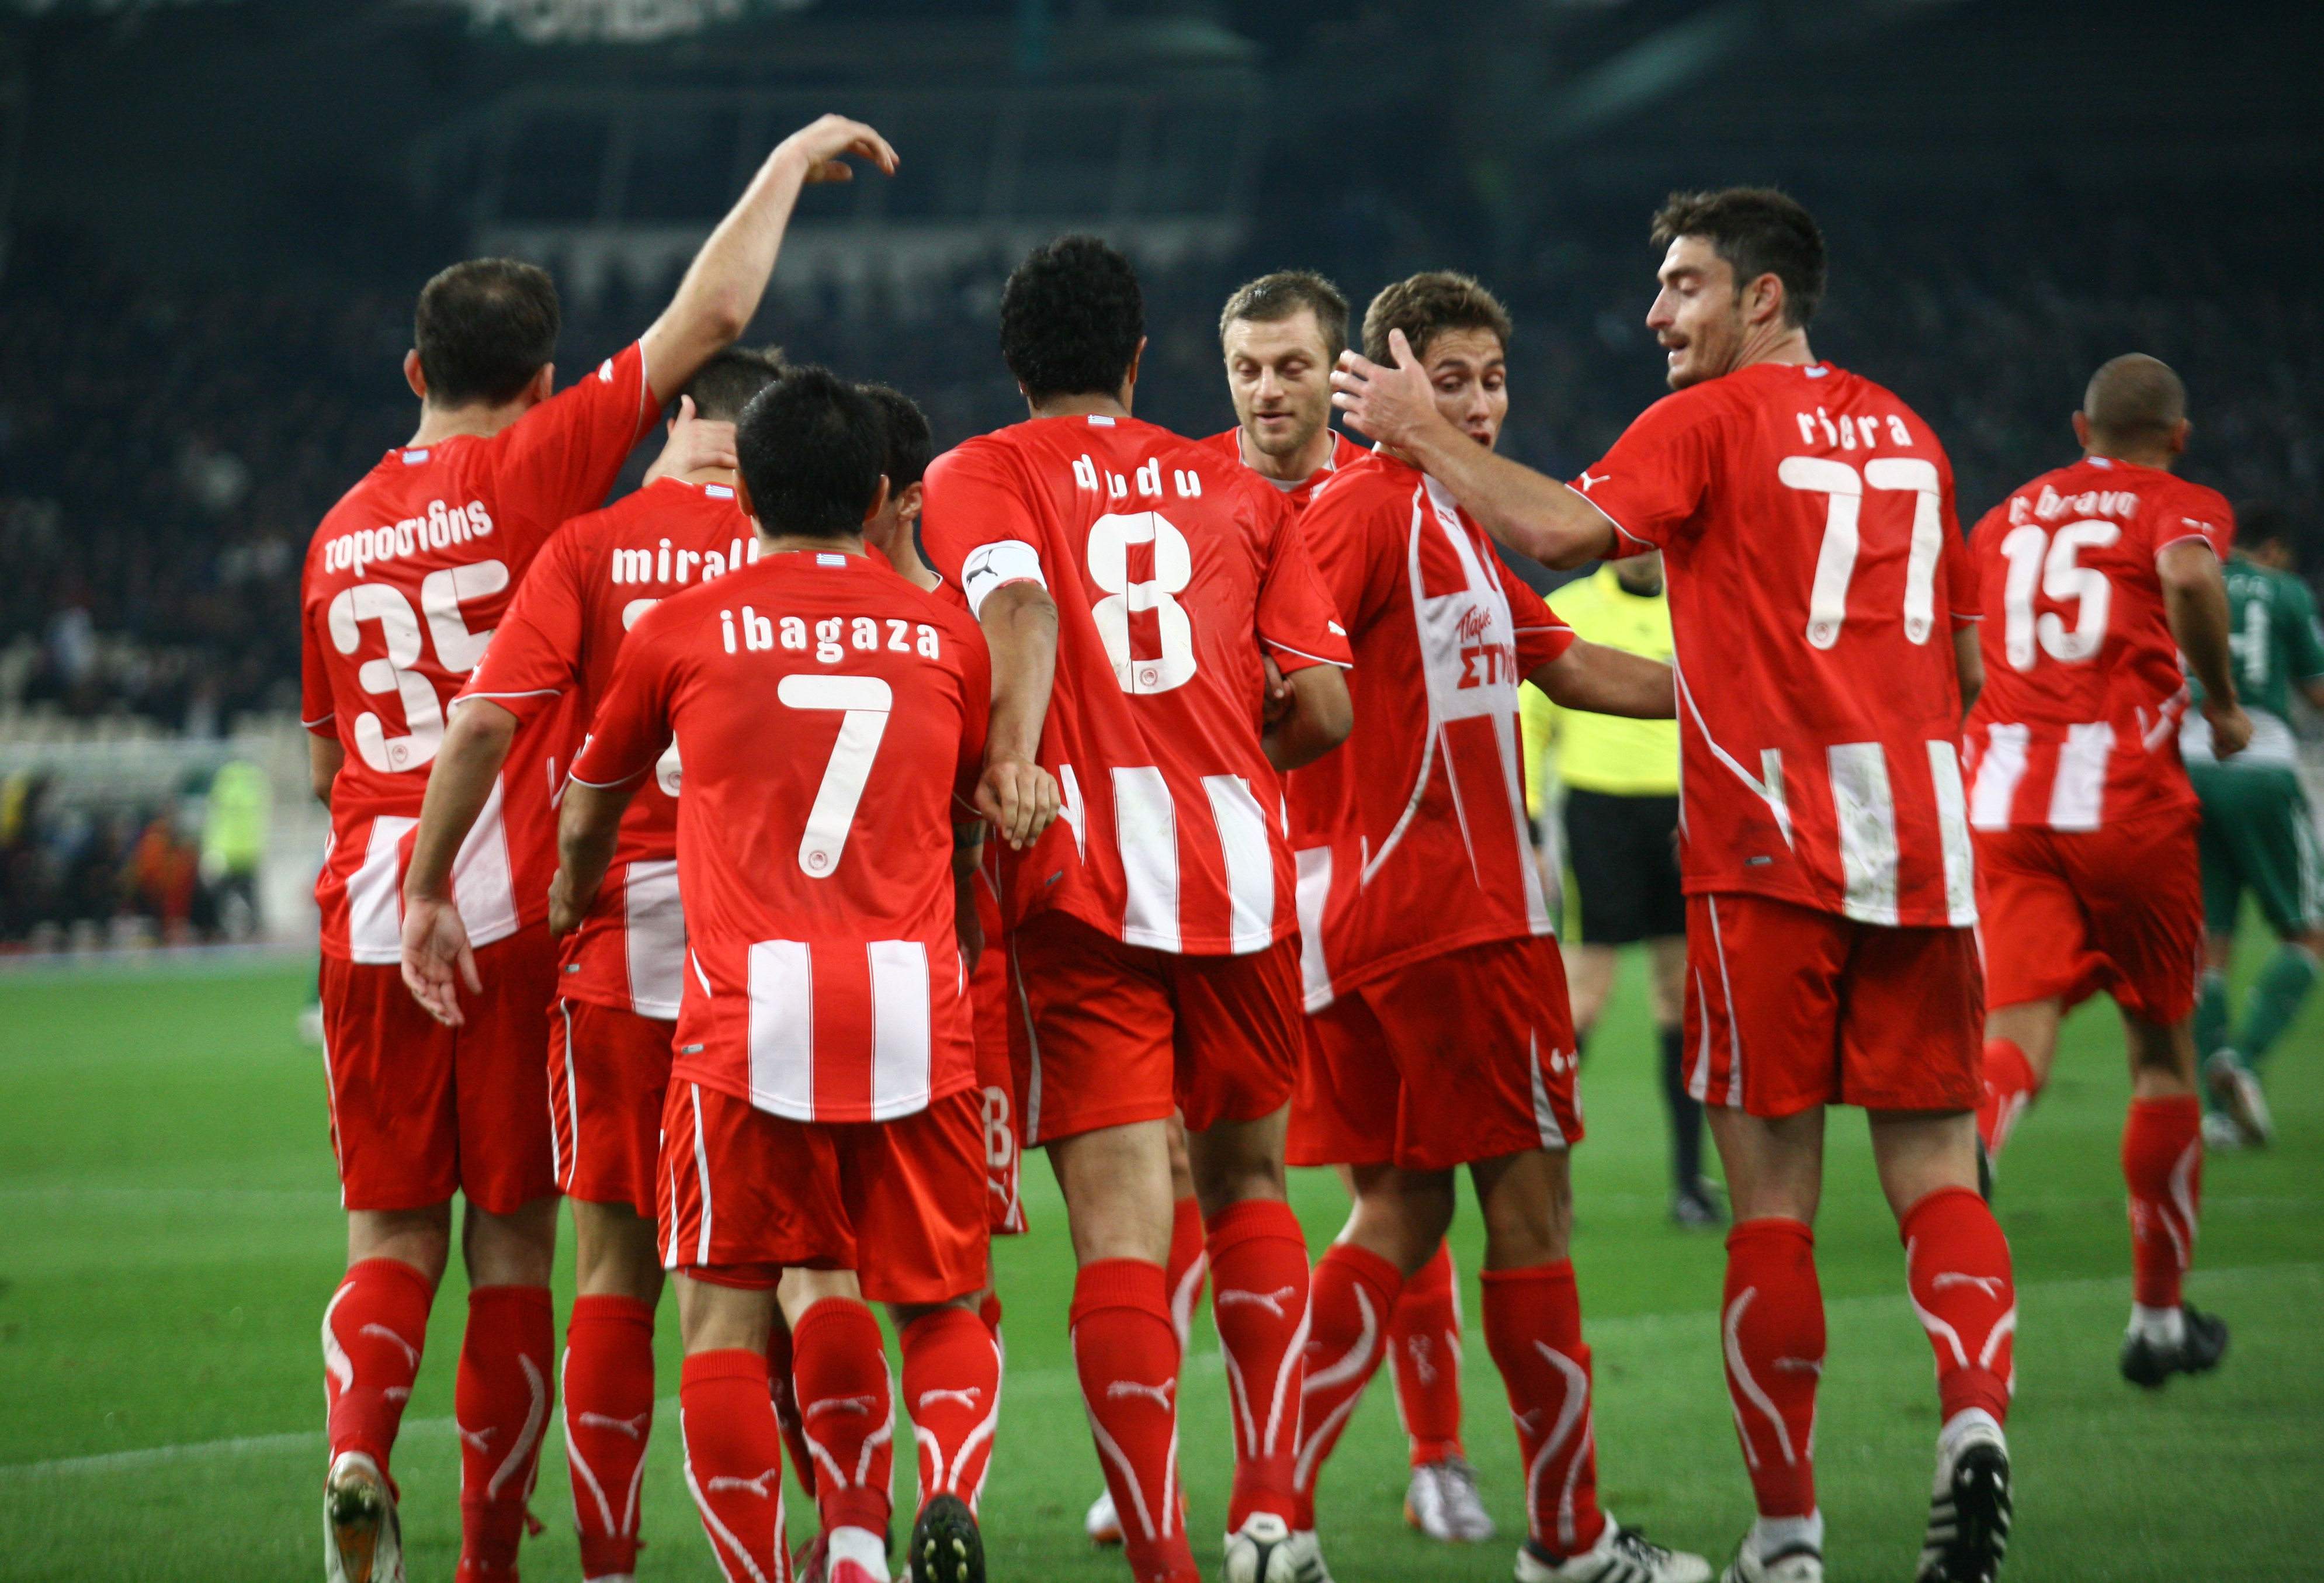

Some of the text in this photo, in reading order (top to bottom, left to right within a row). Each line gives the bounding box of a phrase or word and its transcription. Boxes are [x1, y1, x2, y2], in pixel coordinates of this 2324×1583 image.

[1071, 454, 1201, 498] dudu
[1796, 406, 1913, 451] riera
[611, 536, 759, 584] mirall
[1087, 511, 1198, 694] 8
[1778, 456, 1943, 650] 77
[2000, 519, 2122, 673] 15
[328, 559, 509, 773] 35
[720, 605, 940, 663] ibagaza
[777, 674, 893, 878] 7
